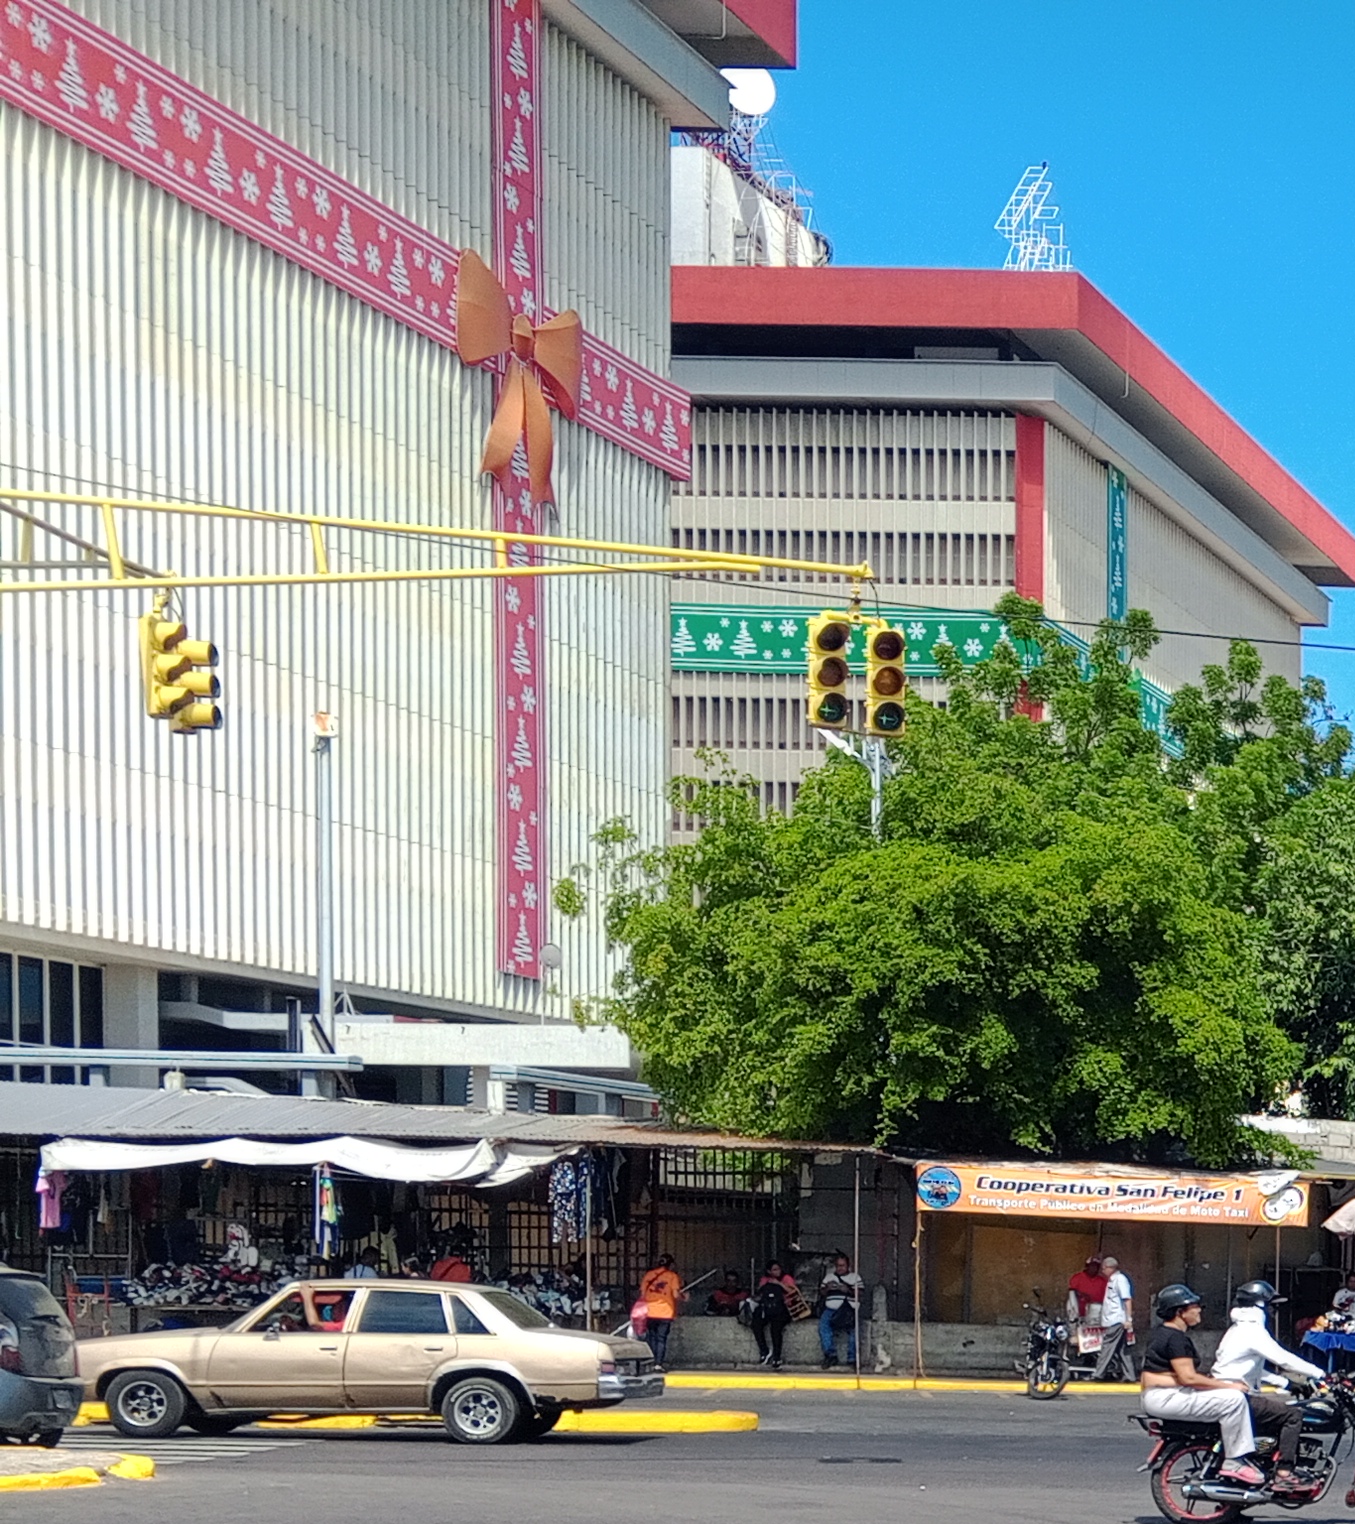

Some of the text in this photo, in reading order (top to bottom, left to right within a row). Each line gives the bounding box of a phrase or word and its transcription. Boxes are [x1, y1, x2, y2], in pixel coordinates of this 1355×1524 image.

[976, 1175, 1242, 1202] Cooperativa San Felipe 1
[969, 1195, 1037, 1211] Transporte
[1172, 1205, 1188, 1216] de
[1190, 1206, 1220, 1217] Moto
[1223, 1207, 1249, 1218] Taxi
